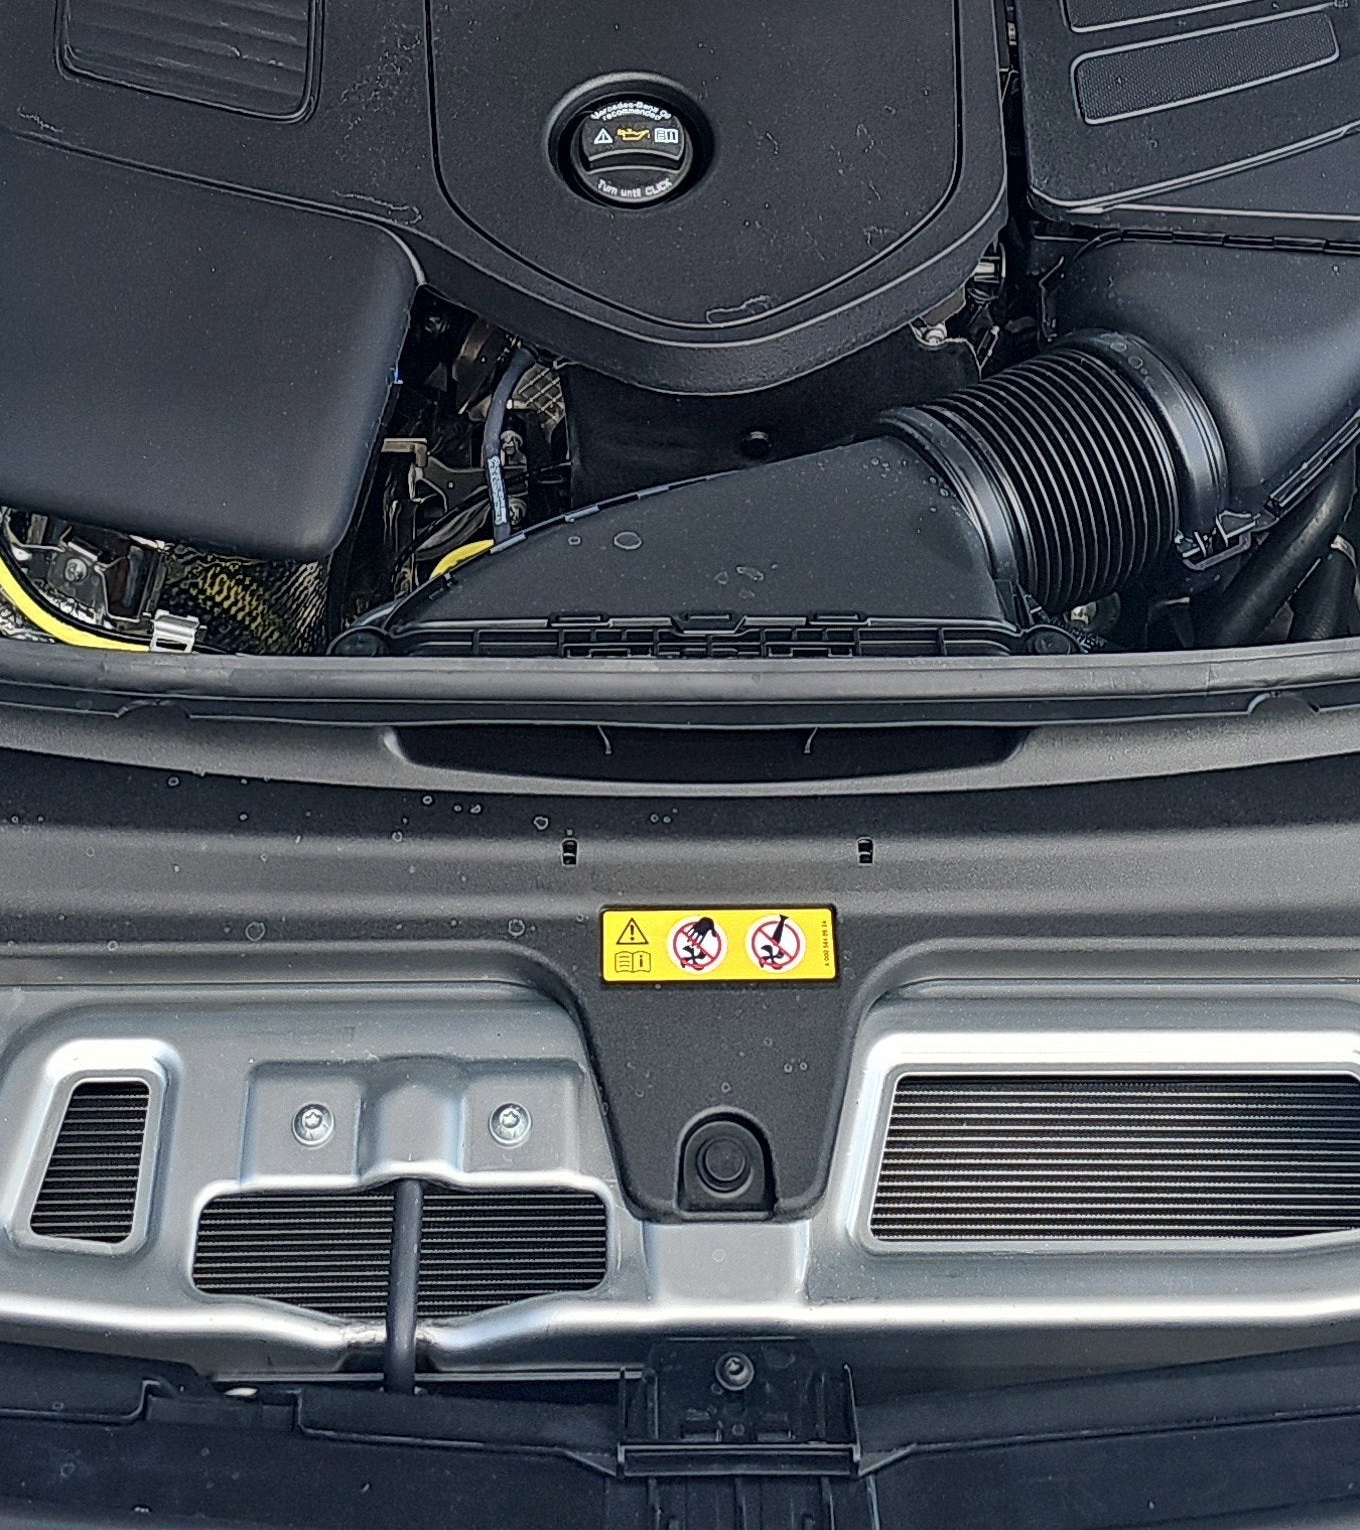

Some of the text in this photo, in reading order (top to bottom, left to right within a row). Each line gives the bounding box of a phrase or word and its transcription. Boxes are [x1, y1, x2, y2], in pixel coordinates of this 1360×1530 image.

[601, 108, 661, 120] recommended
[597, 178, 672, 197] Turn until CLICK
